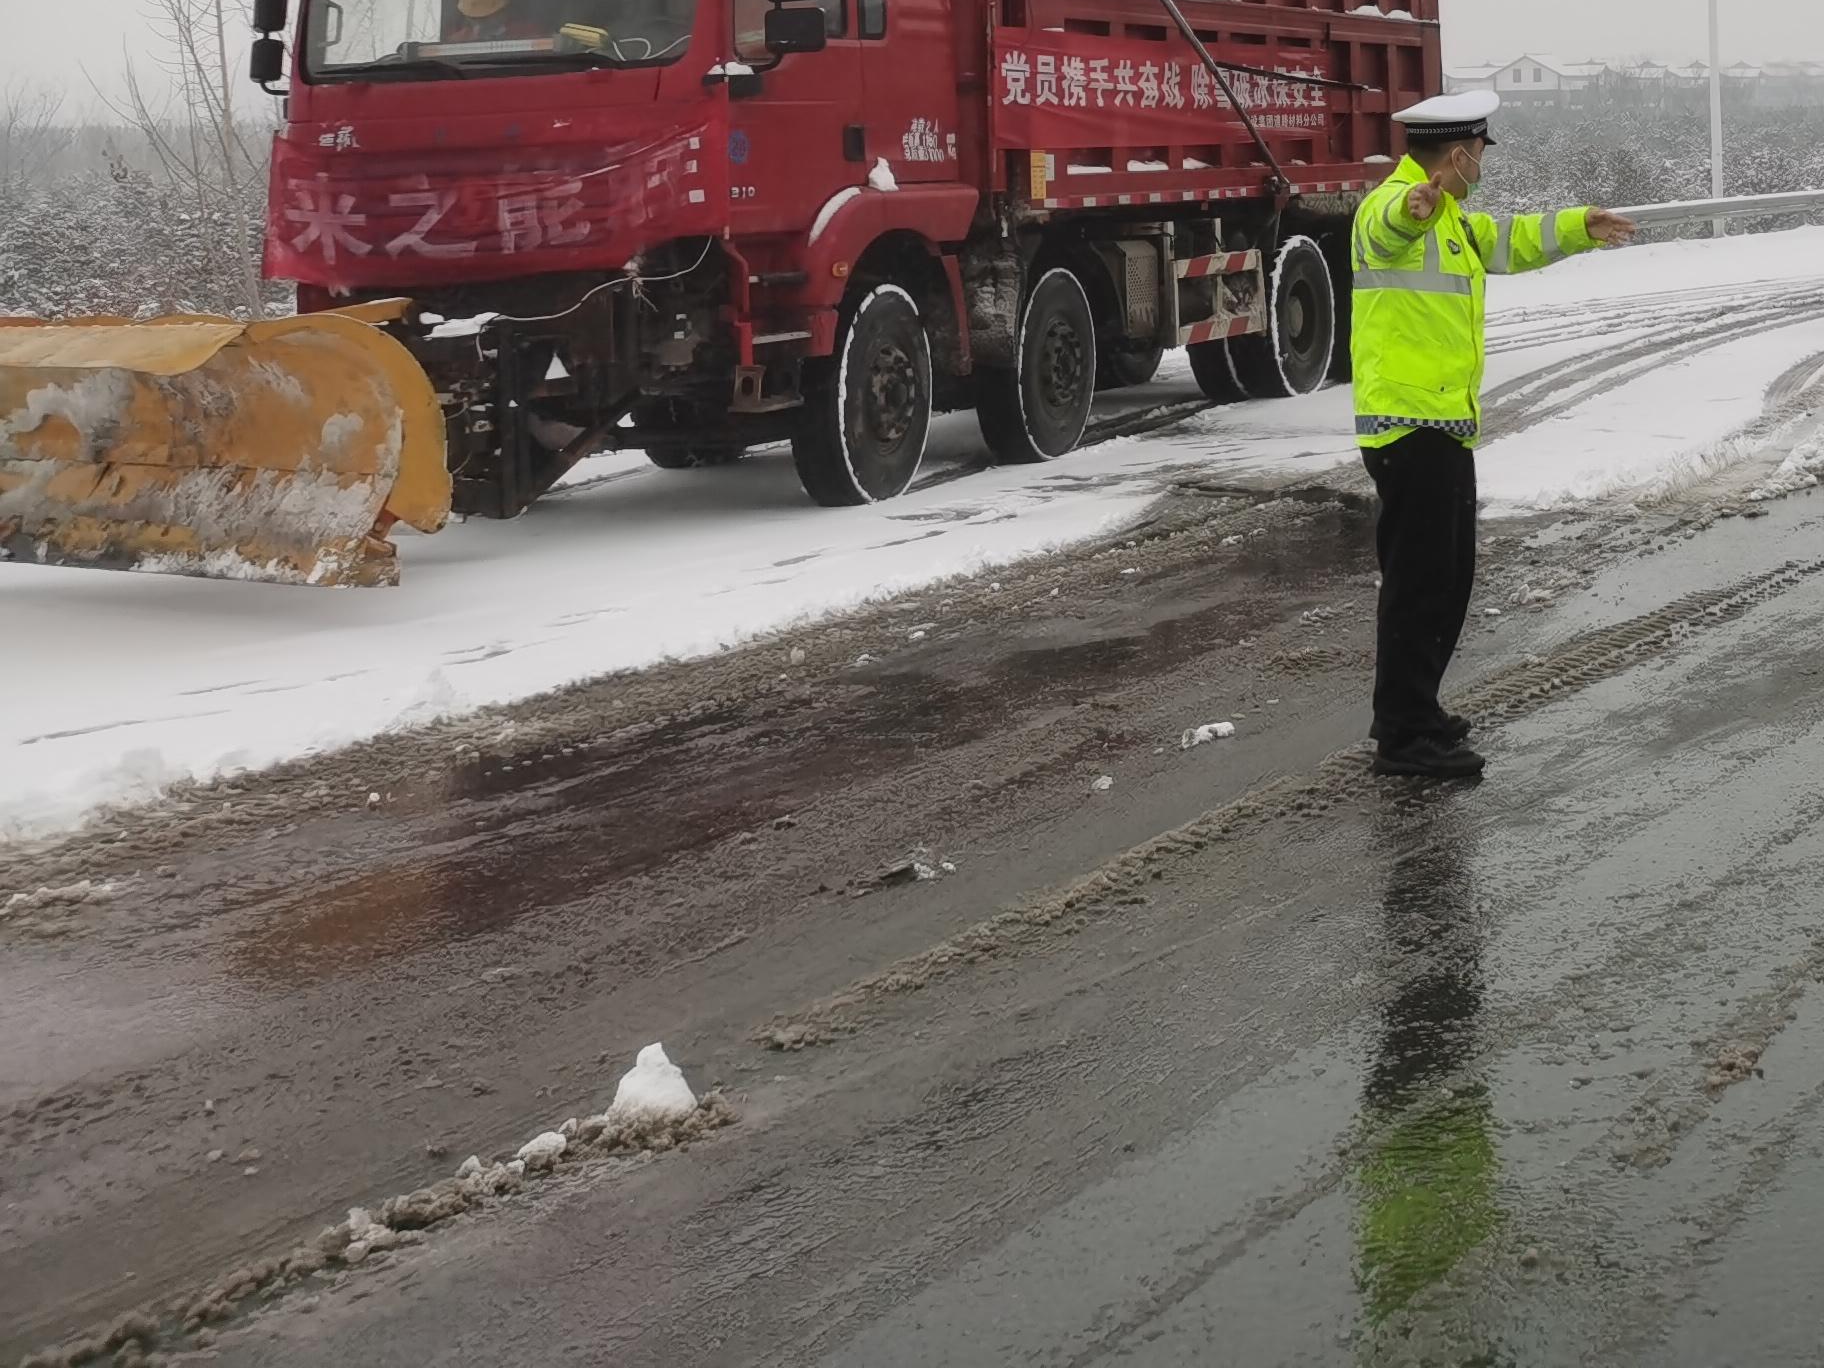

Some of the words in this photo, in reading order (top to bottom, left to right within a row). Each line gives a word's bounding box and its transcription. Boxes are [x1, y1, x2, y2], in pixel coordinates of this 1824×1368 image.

[1001, 50, 1184, 110] 党员携手共奋战
